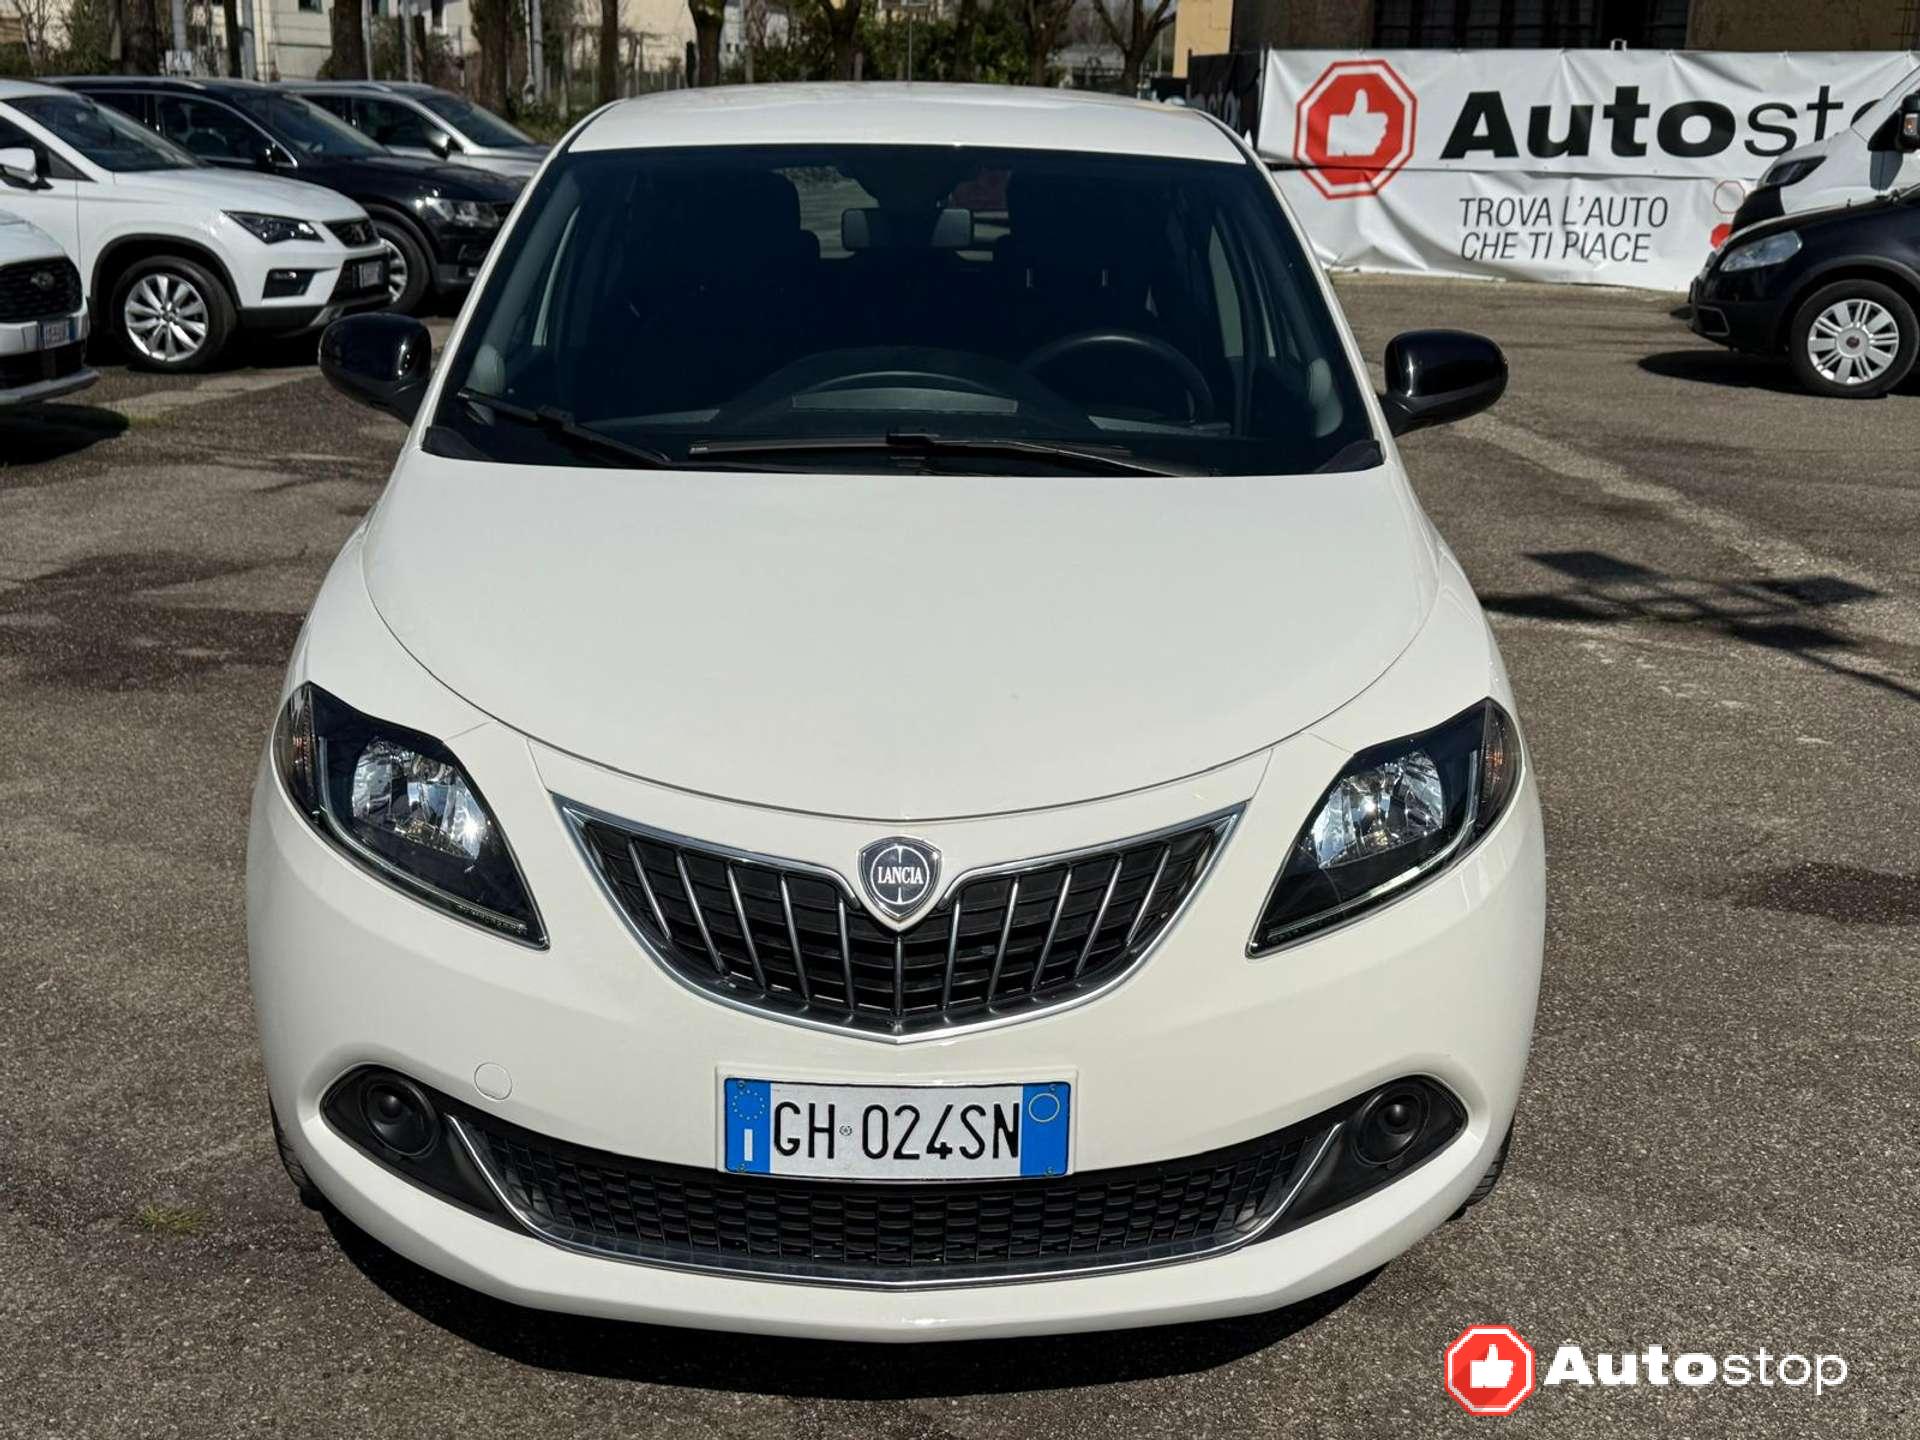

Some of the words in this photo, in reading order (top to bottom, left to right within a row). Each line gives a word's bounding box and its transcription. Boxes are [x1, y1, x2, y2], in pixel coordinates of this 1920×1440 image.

[1439, 86, 1882, 159] Autost
[1459, 197, 1552, 227] TROVA
[1562, 196, 1669, 228] L'AUTO
[1460, 232, 1518, 261] CHE
[1529, 232, 1553, 260] TI
[1562, 231, 1652, 262] PIACE
[877, 866, 924, 885] LANCIA
[773, 1101, 836, 1159] GH
[861, 1103, 1020, 1161] 024SN
